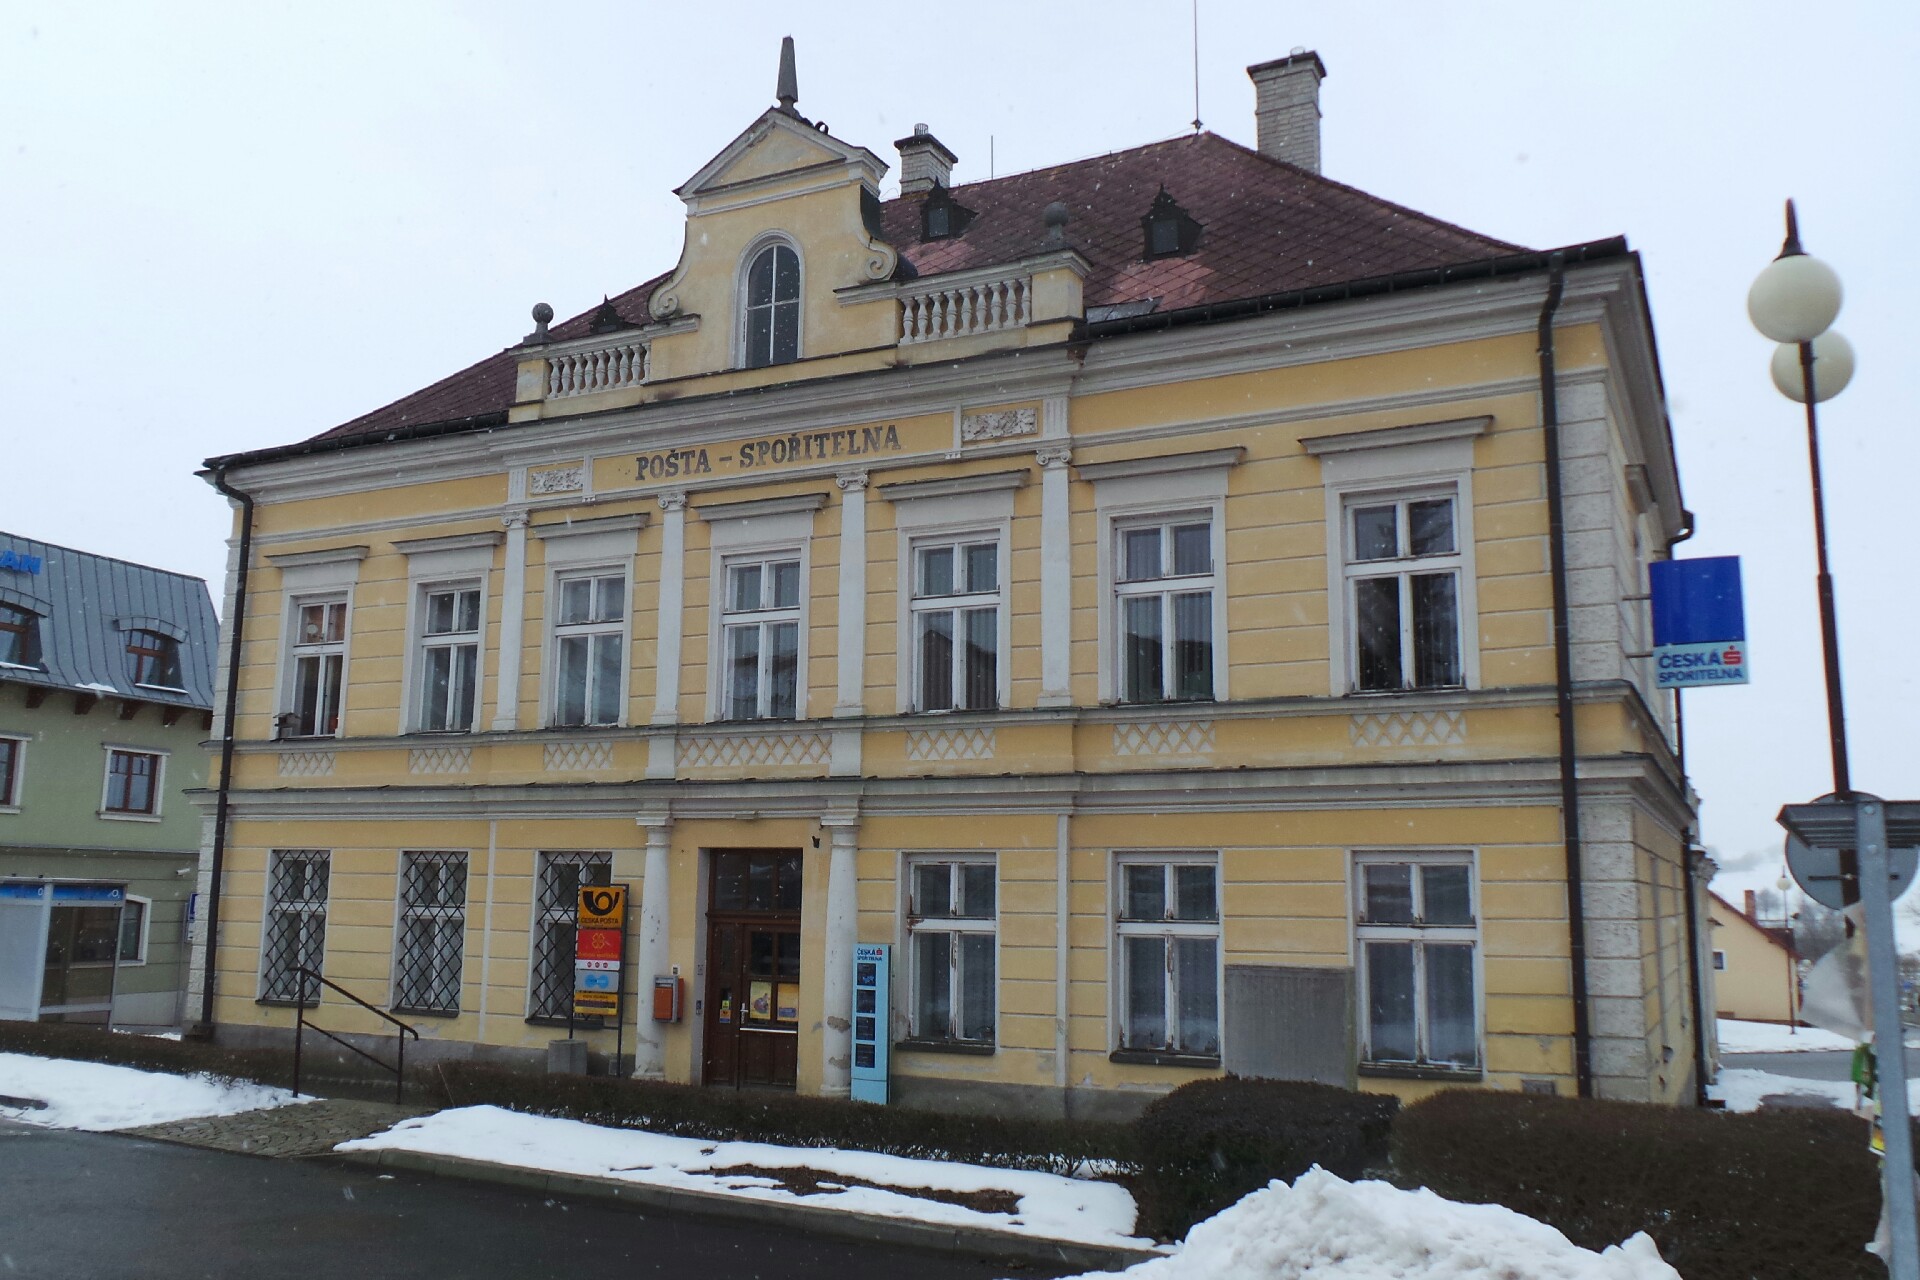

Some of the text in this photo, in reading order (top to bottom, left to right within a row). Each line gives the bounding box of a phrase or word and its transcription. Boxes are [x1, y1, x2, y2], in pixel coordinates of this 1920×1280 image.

[635, 448, 711, 481] POŠTA
[739, 424, 900, 468] SPOŘITELNA
[1658, 648, 1721, 669] ČESKÁ
